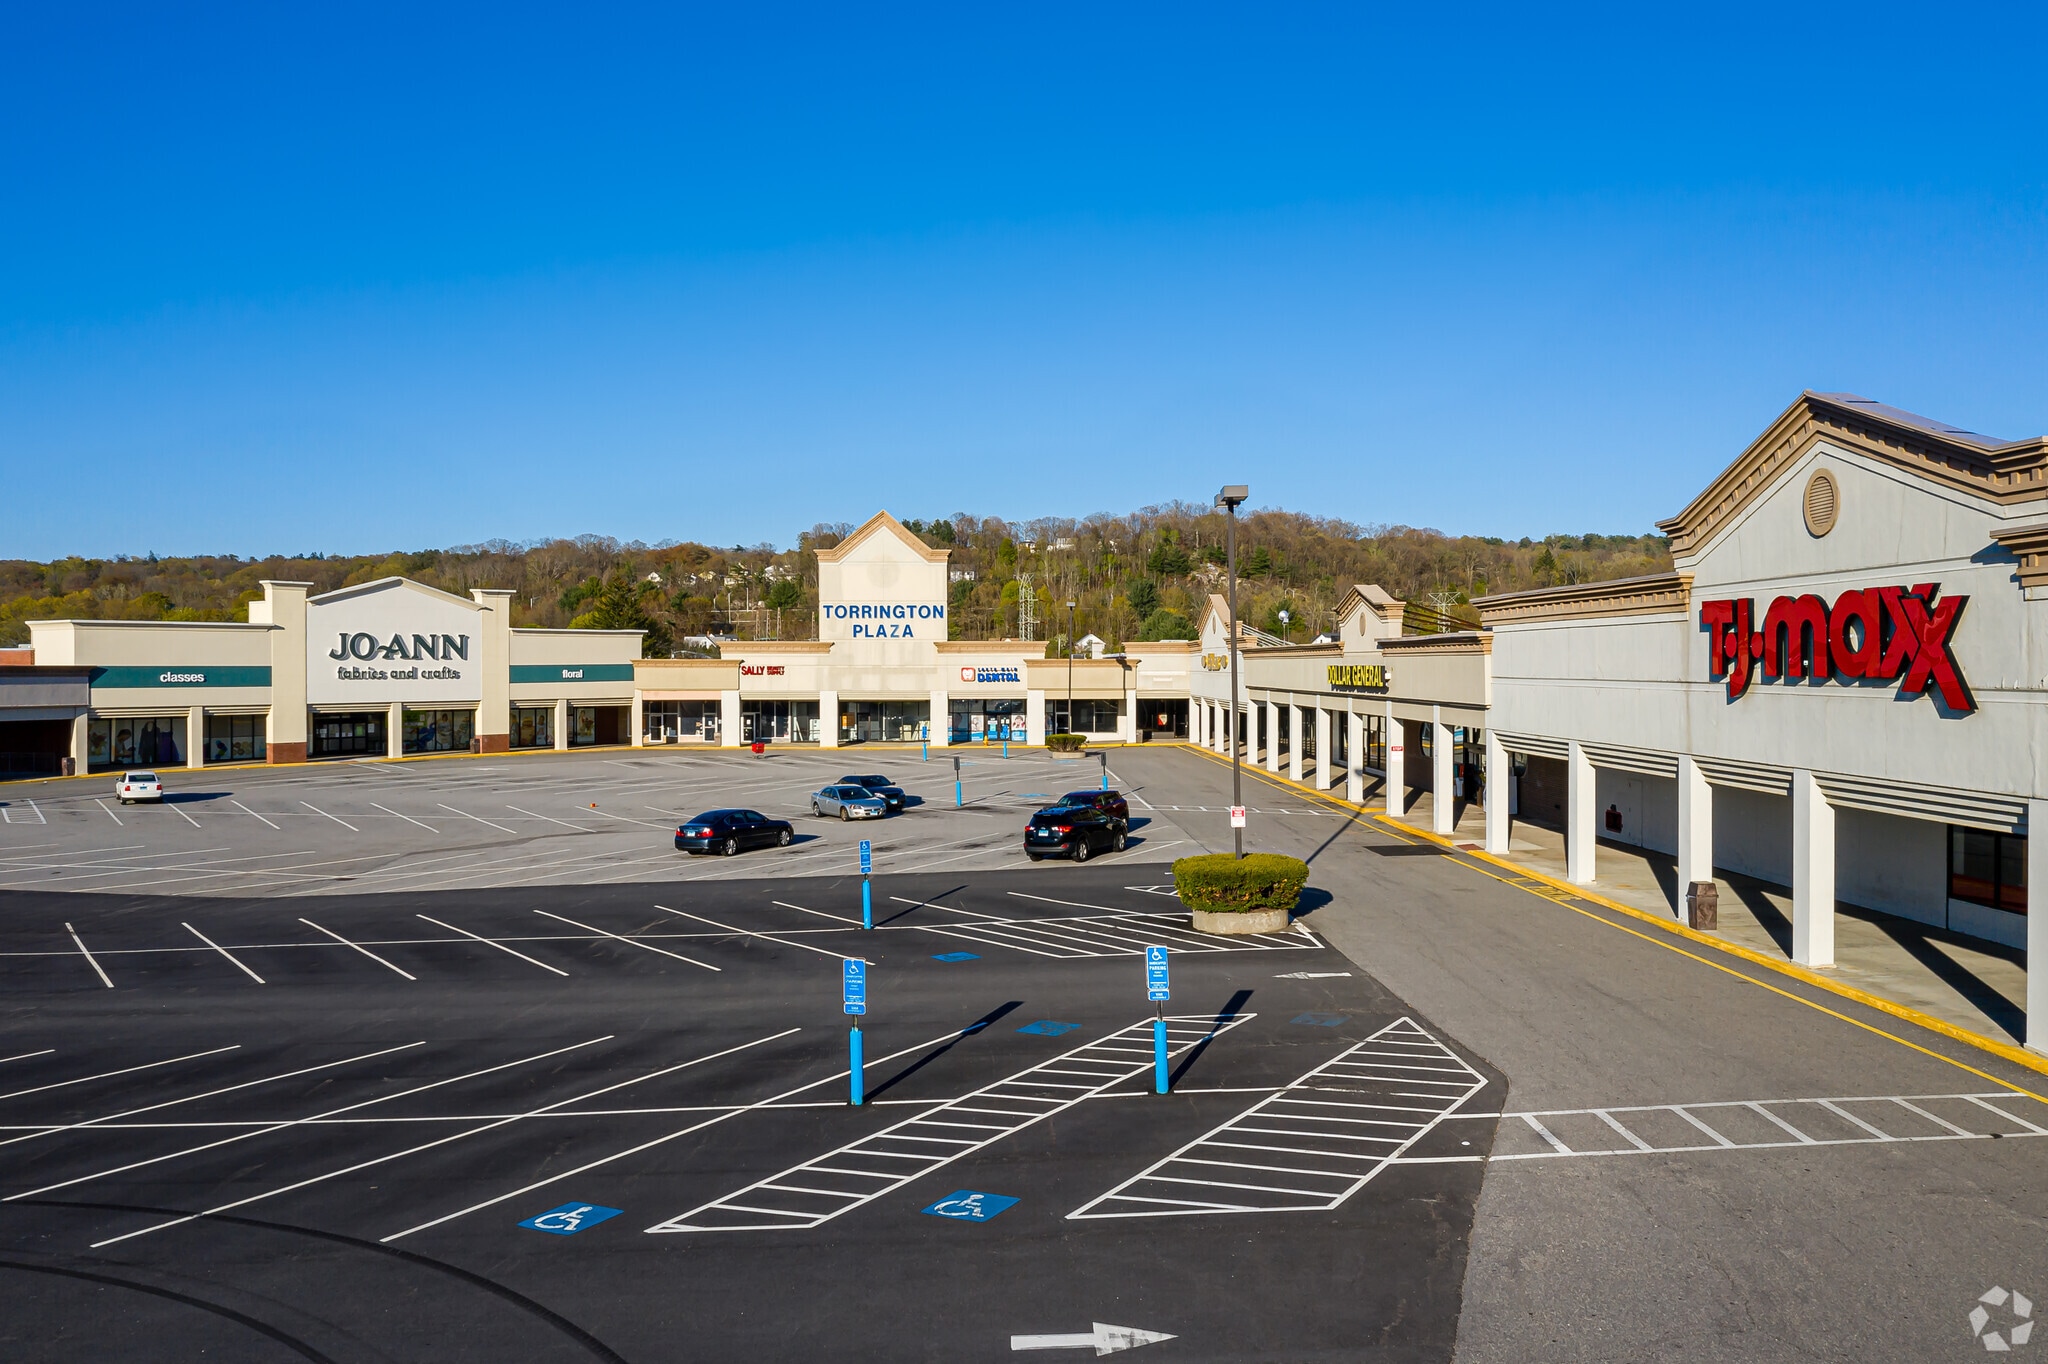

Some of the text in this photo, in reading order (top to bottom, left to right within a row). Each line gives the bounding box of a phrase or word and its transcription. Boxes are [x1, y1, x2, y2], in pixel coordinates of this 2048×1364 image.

[822, 605, 944, 619] TORRINGTON
[852, 624, 914, 638] PLAZA
[160, 671, 205, 683] classes
[338, 666, 459, 680] fabrics and crafts
[562, 669, 583, 678] floral
[741, 665, 765, 676] SALLY
[1327, 665, 1384, 687] DOLLAR GENERAL
[977, 673, 1020, 682] DENTAL
